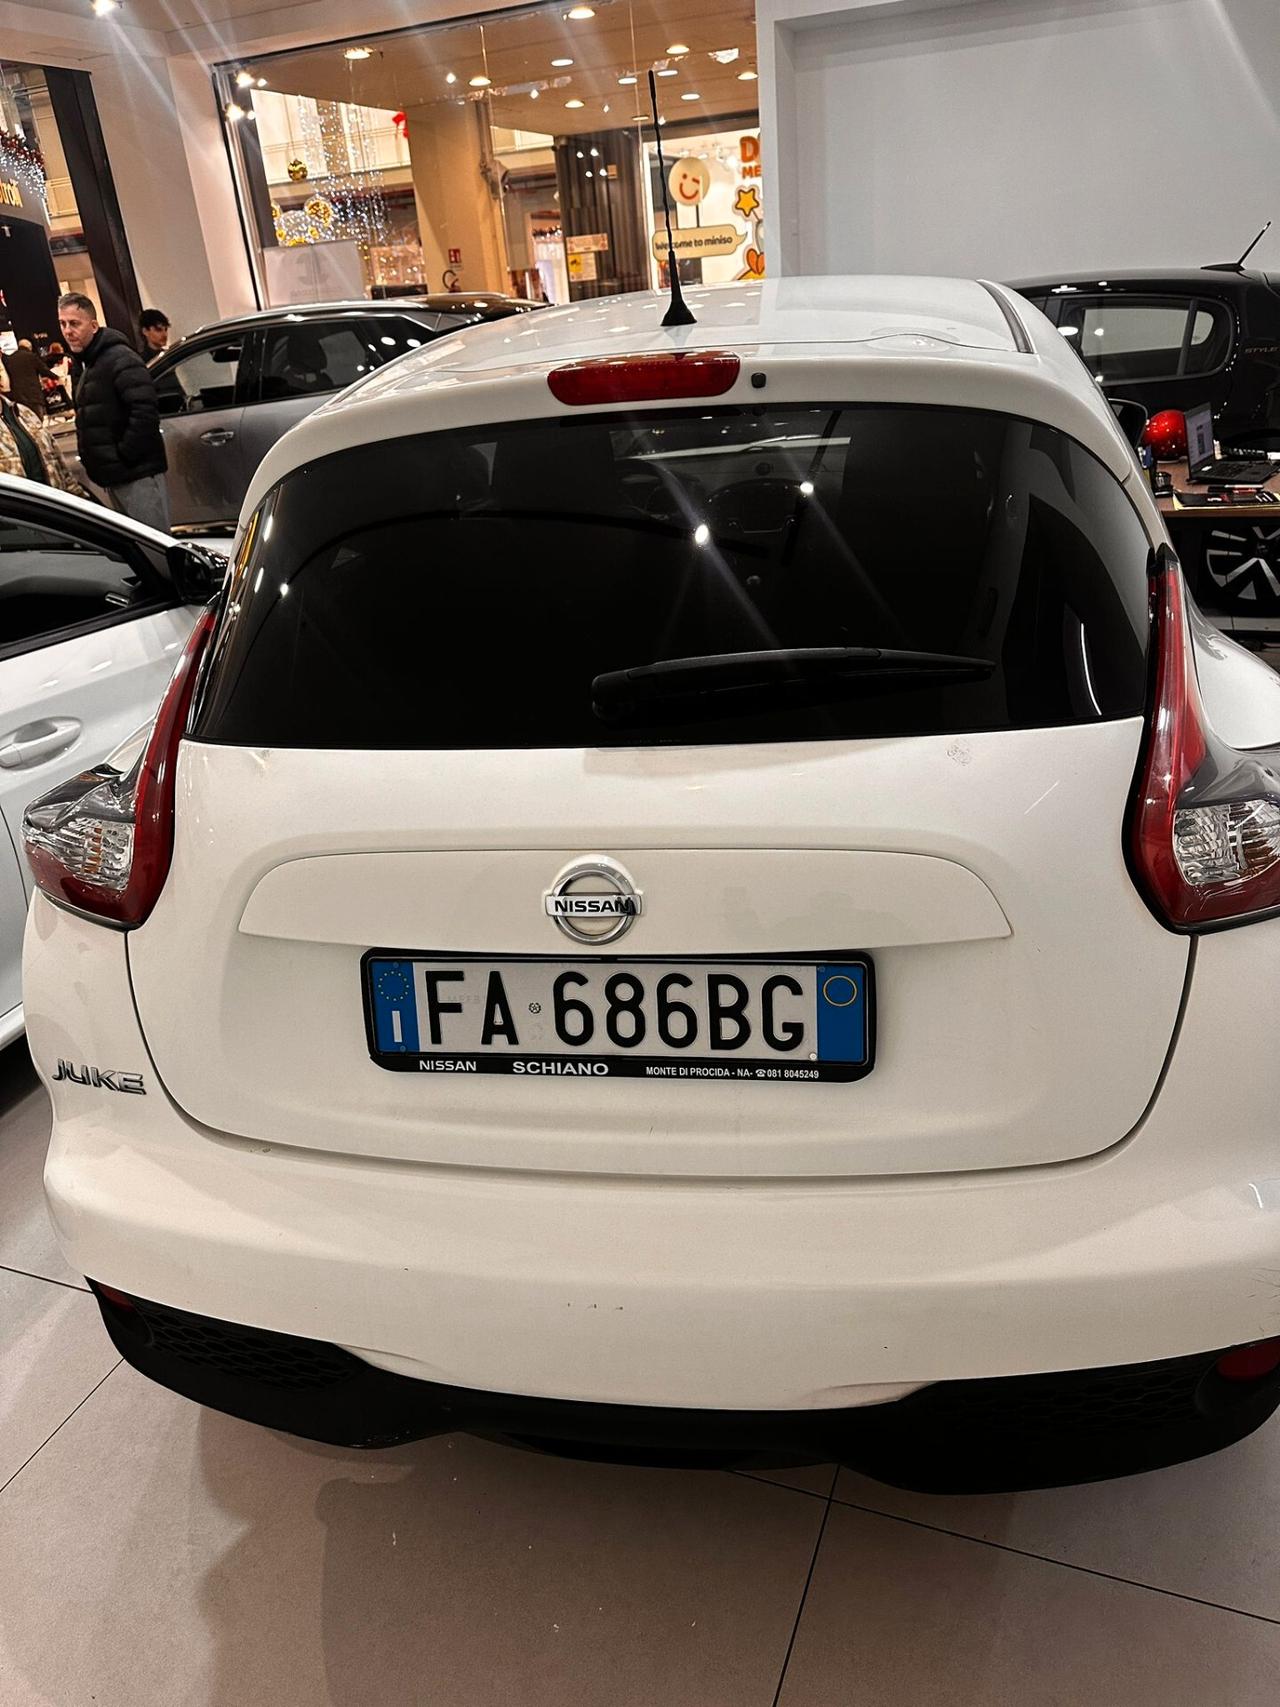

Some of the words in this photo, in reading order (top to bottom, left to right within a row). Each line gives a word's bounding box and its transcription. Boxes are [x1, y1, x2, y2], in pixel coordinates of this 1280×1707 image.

[694, 238, 704, 247] to
[704, 235, 733, 246] miniso
[554, 896, 636, 915] NISSAN
[552, 971, 804, 1051] 686BG
[52, 1058, 147, 1095] JUKE
[419, 1060, 477, 1072] NISSAN
[512, 1061, 609, 1076] SCHIANO
[646, 1066, 677, 1076] MONTE
[679, 1067, 689, 1076] DI
[690, 1067, 730, 1077] PROCIDA
[766, 1071, 782, 1079] 081
[784, 1071, 820, 1079] 8045249
